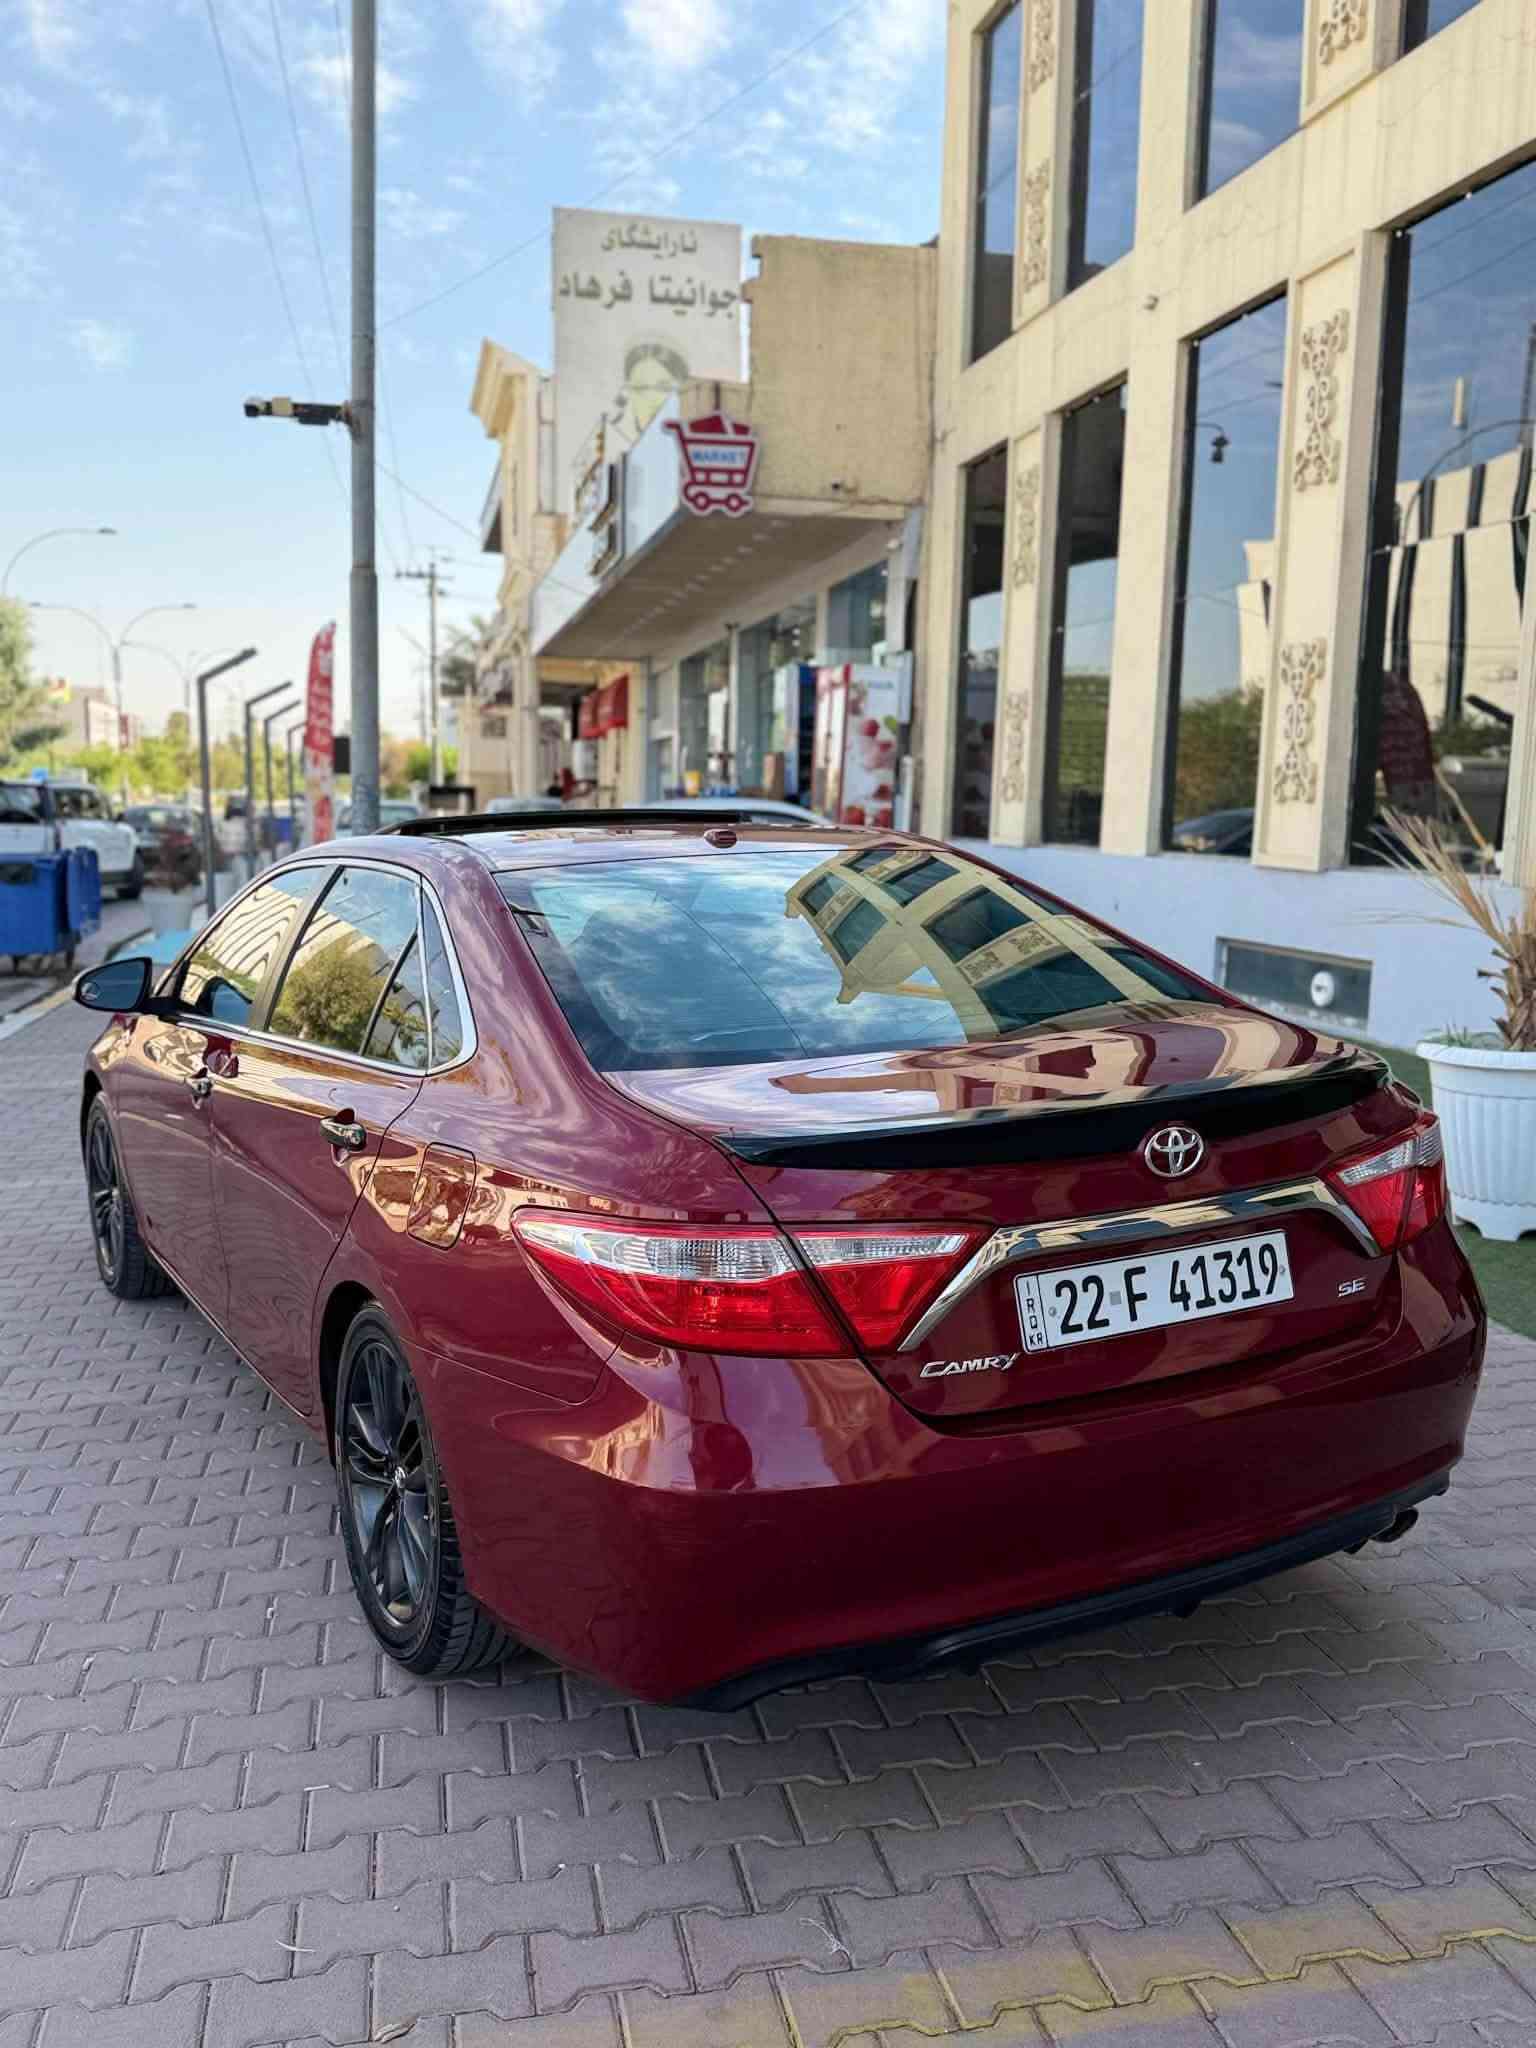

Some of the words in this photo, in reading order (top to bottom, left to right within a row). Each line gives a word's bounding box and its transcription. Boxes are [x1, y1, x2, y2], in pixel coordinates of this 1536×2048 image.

[1055, 1275, 1110, 1335] 22
[1124, 1266, 1148, 1322] F
[1169, 1243, 1279, 1312] 41319
[1337, 1277, 1368, 1297] SE
[919, 1352, 1020, 1378] CAMRY
